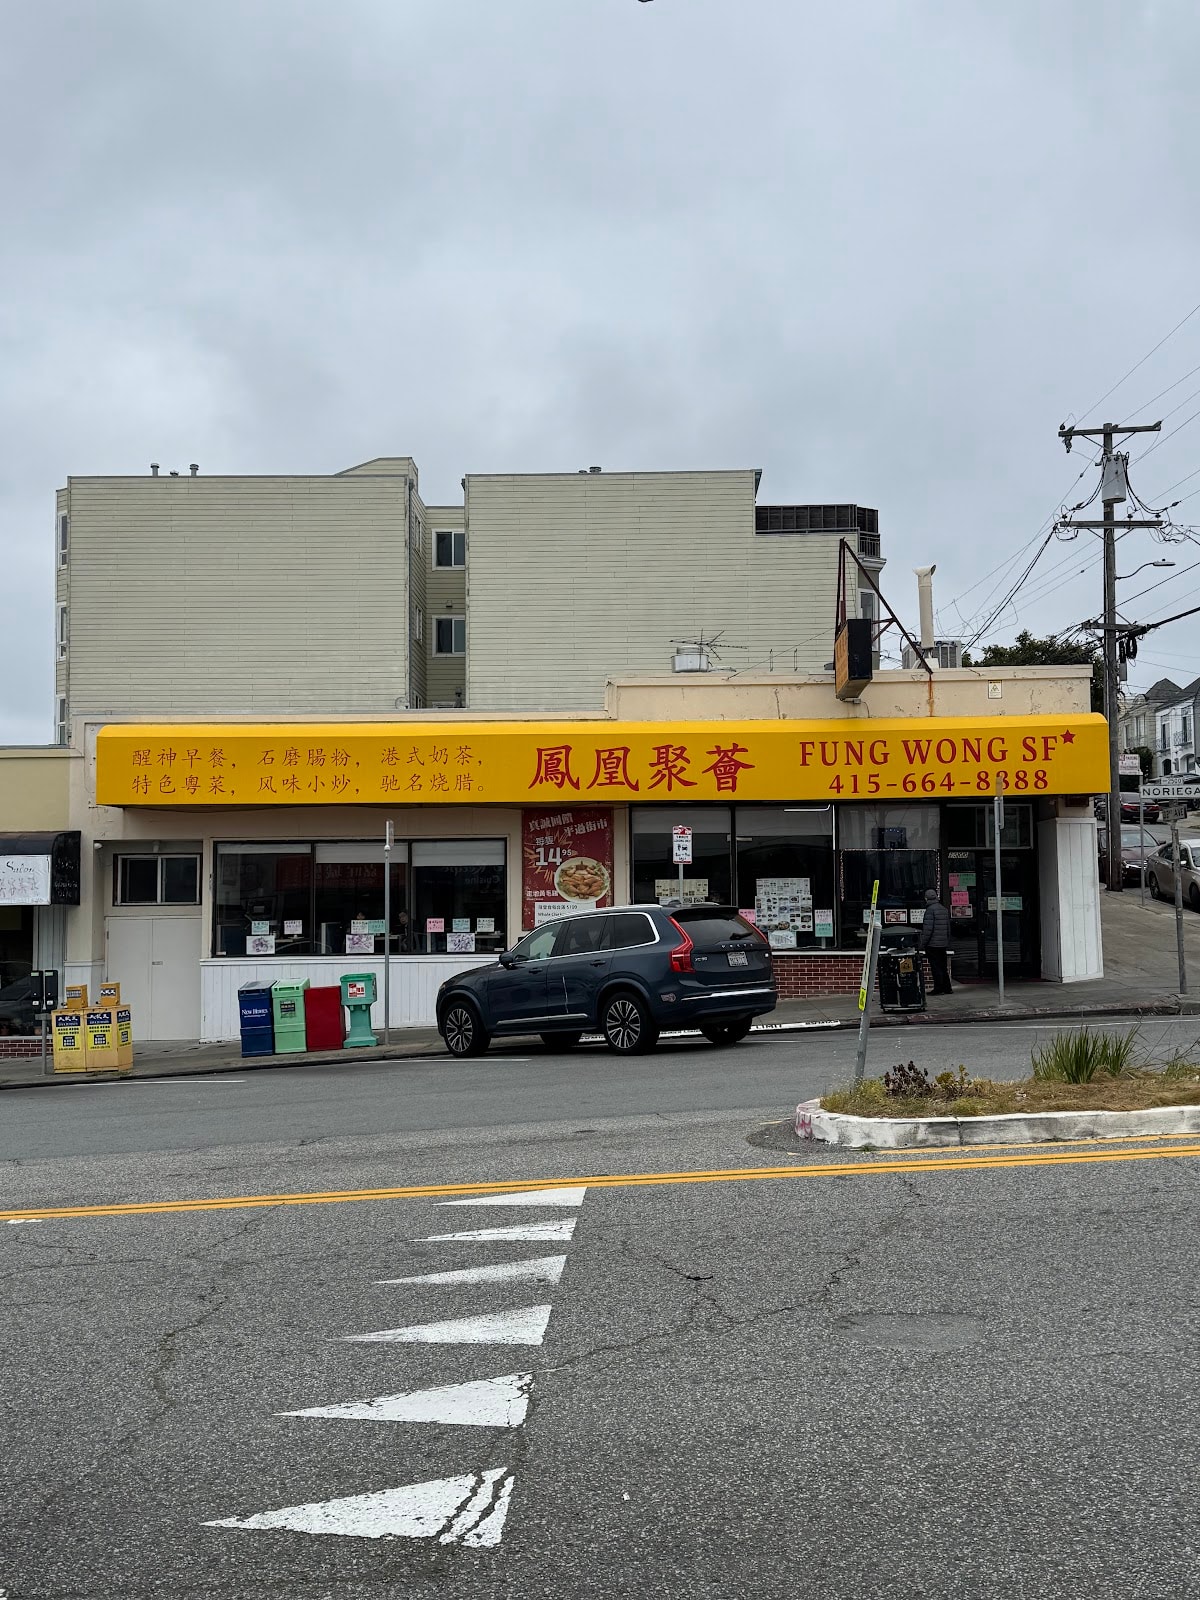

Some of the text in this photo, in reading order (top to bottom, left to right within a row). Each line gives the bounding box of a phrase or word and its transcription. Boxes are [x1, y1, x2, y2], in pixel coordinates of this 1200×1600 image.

[799, 735, 1058, 766] FUNG WONG SF
[528, 743, 756, 792] 鳳凰聚薈
[536, 847, 562, 866] 14
